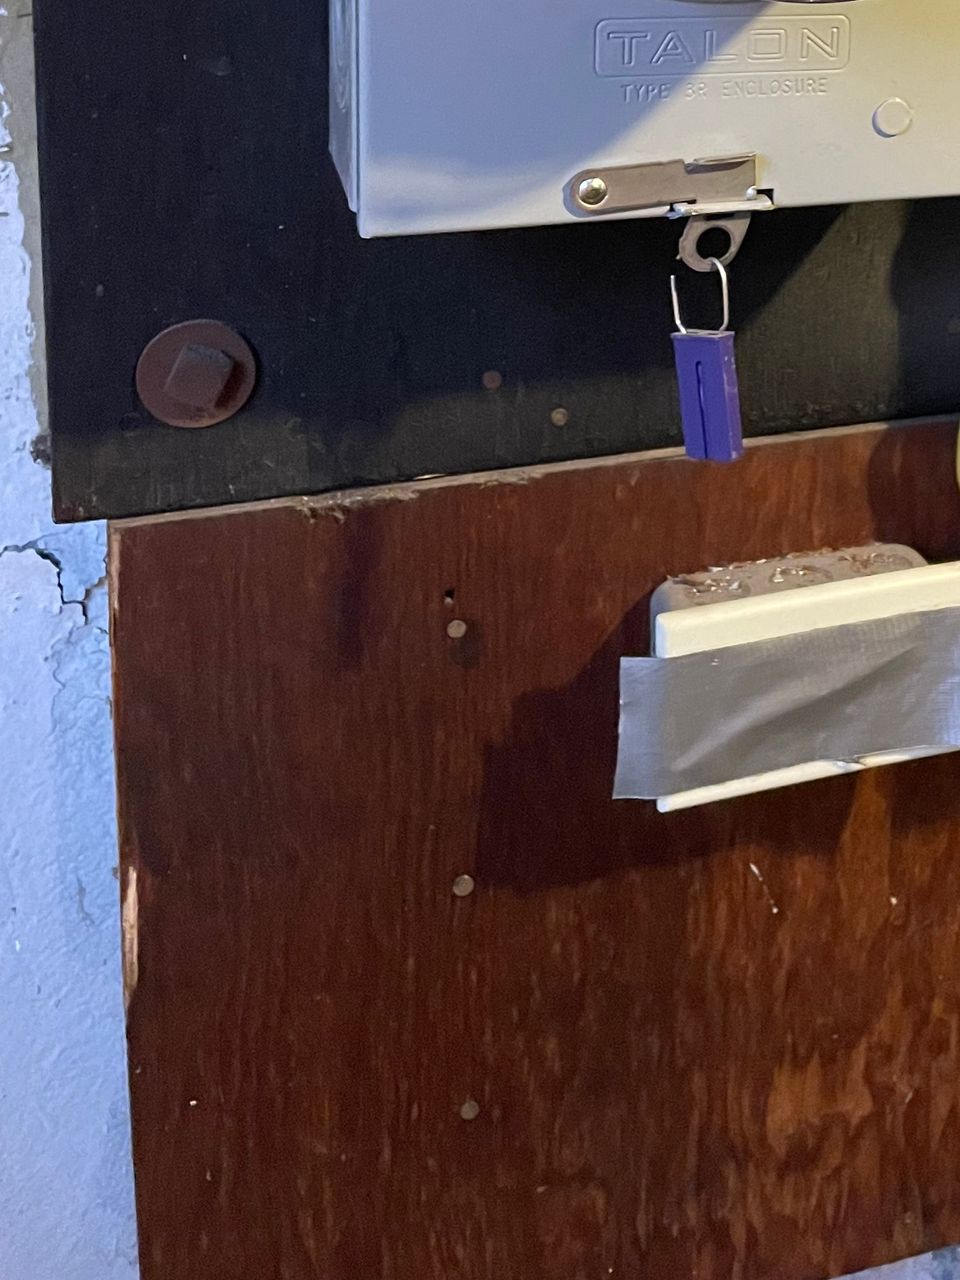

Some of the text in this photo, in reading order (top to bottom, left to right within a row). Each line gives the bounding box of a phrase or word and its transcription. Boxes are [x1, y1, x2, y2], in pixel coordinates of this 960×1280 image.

[607, 27, 841, 67] TALON
[620, 82, 671, 103] TYPE
[721, 78, 828, 100] ENCLOSURE
